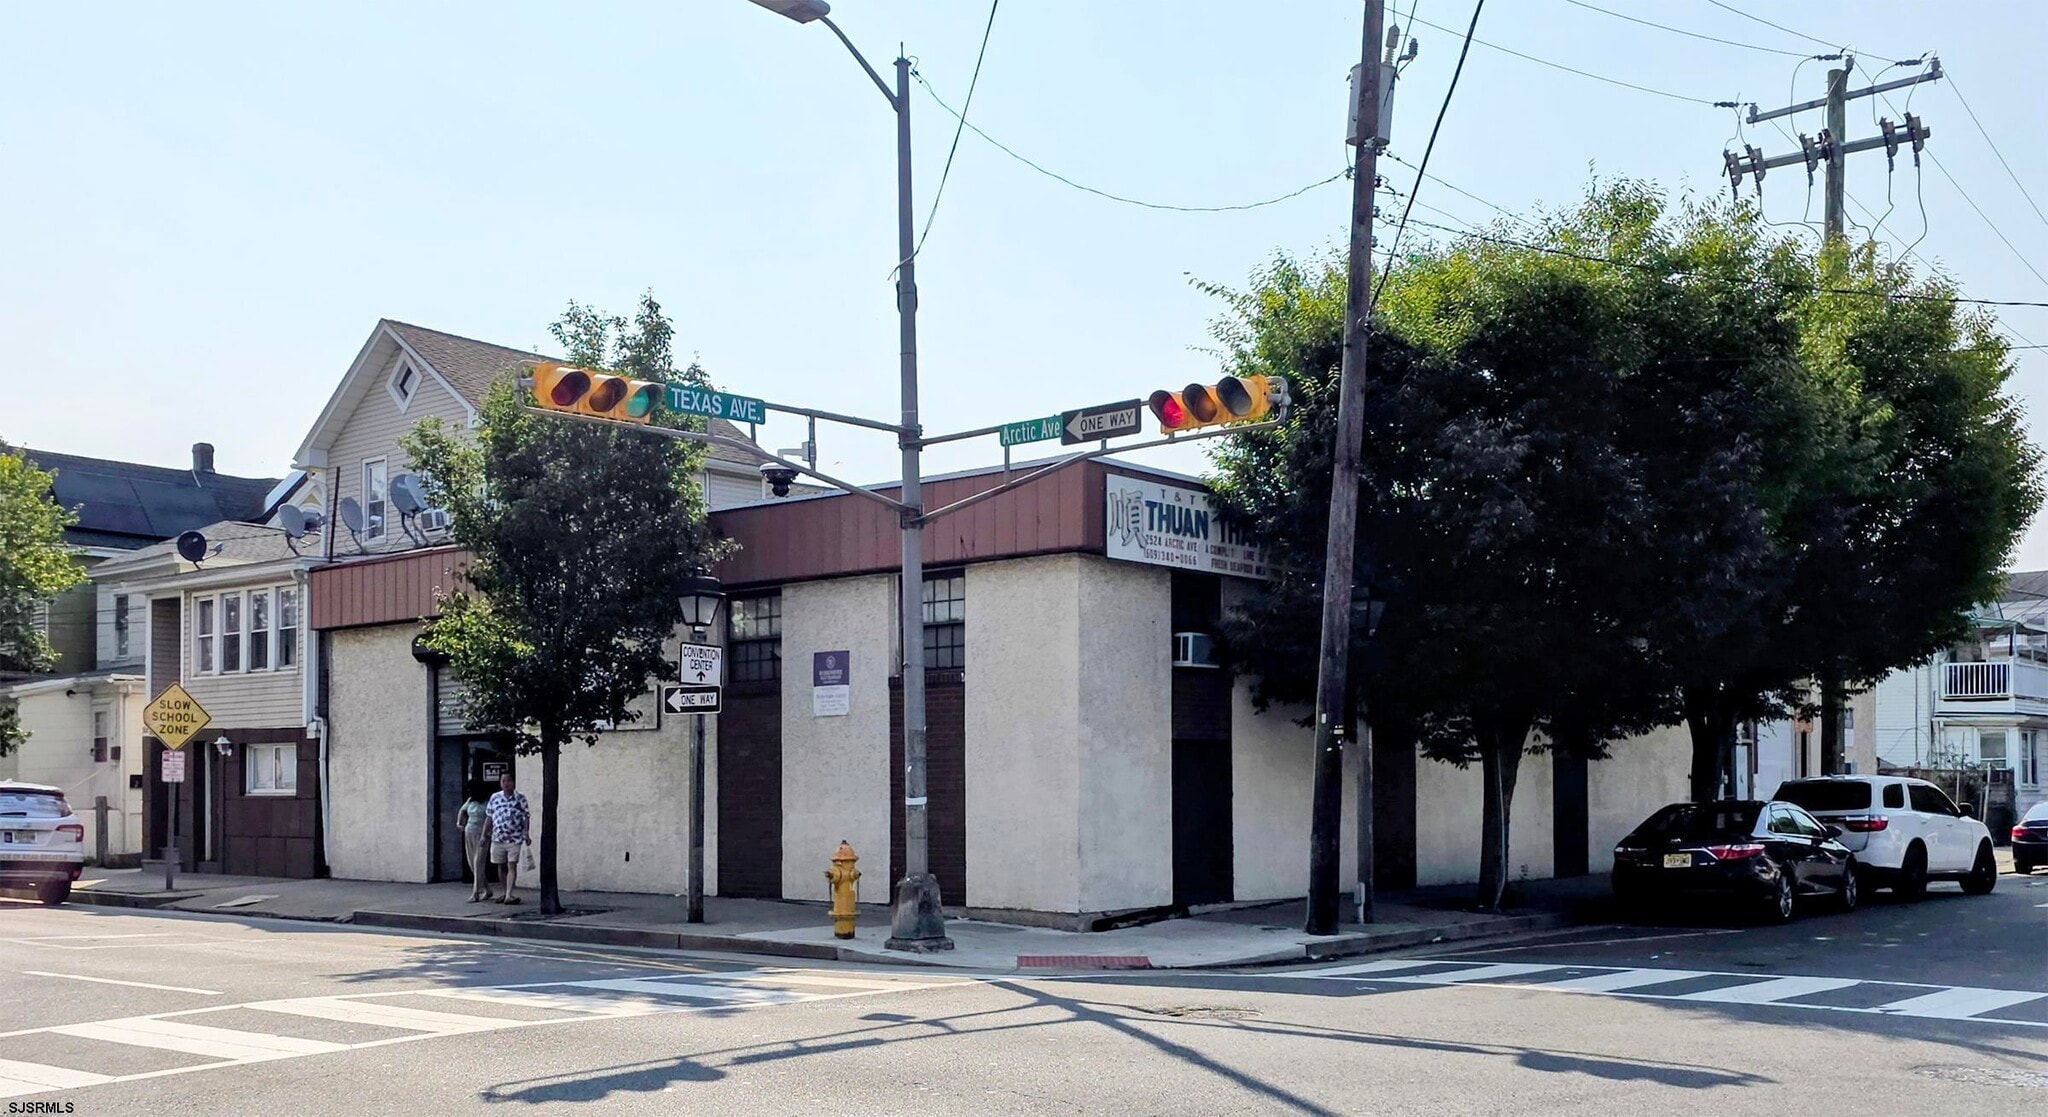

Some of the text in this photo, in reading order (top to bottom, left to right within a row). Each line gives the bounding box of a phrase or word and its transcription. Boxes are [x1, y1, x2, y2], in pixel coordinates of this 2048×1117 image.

[671, 388, 761, 421] TEXAS AVE.
[1080, 410, 1134, 432] ONE WAY
[1003, 420, 1060, 445] Arctic Ave
[1160, 488, 1167, 499] T
[1145, 500, 1209, 539] THUAN
[1145, 534, 1198, 552] 2524 ARCTIC AVE
[683, 646, 720, 661] CONVENTION
[690, 659, 713, 671] CENTER
[160, 700, 191, 710] SLOW
[681, 694, 715, 706] ONE WAY
[152, 711, 198, 723] SCHOOL
[159, 725, 190, 735] ZONE
